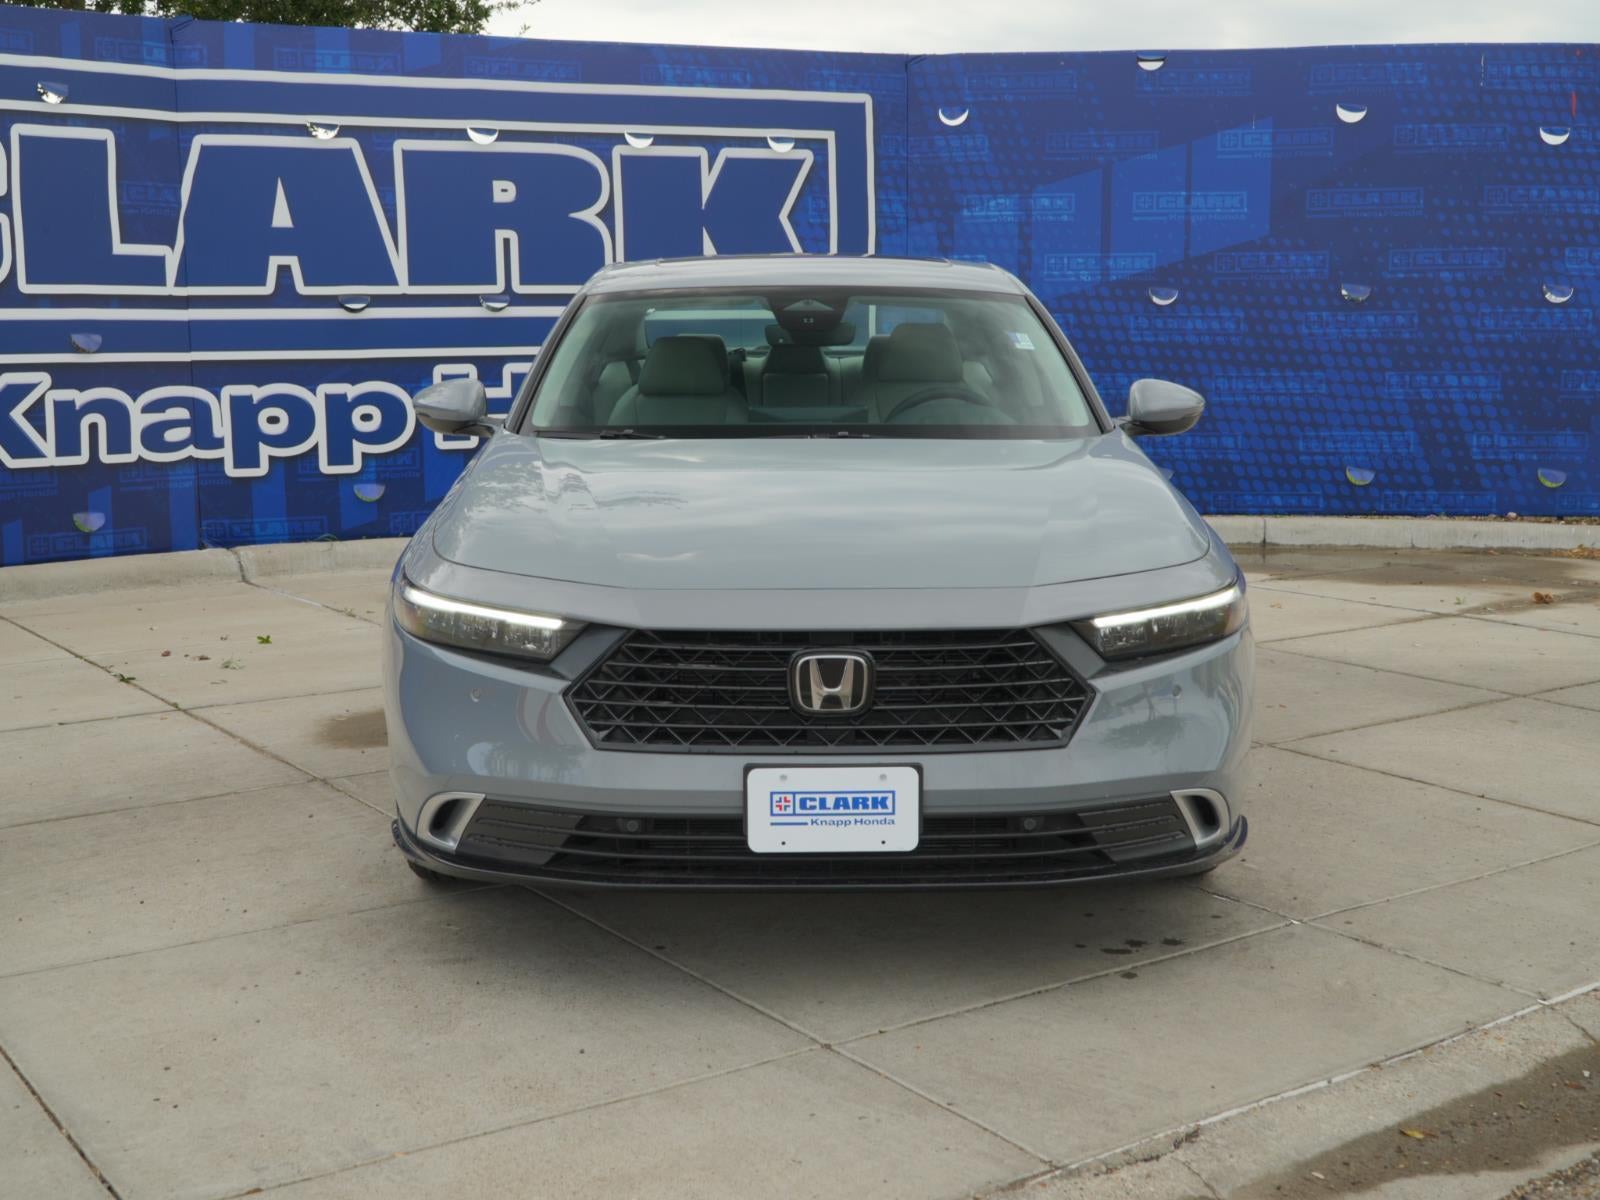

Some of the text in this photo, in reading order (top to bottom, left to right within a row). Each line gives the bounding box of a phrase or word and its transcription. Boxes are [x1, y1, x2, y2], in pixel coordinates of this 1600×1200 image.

[0, 123, 814, 296] LARK
[799, 796, 890, 811] CLARK
[810, 817, 895, 828] Knapp Honda
